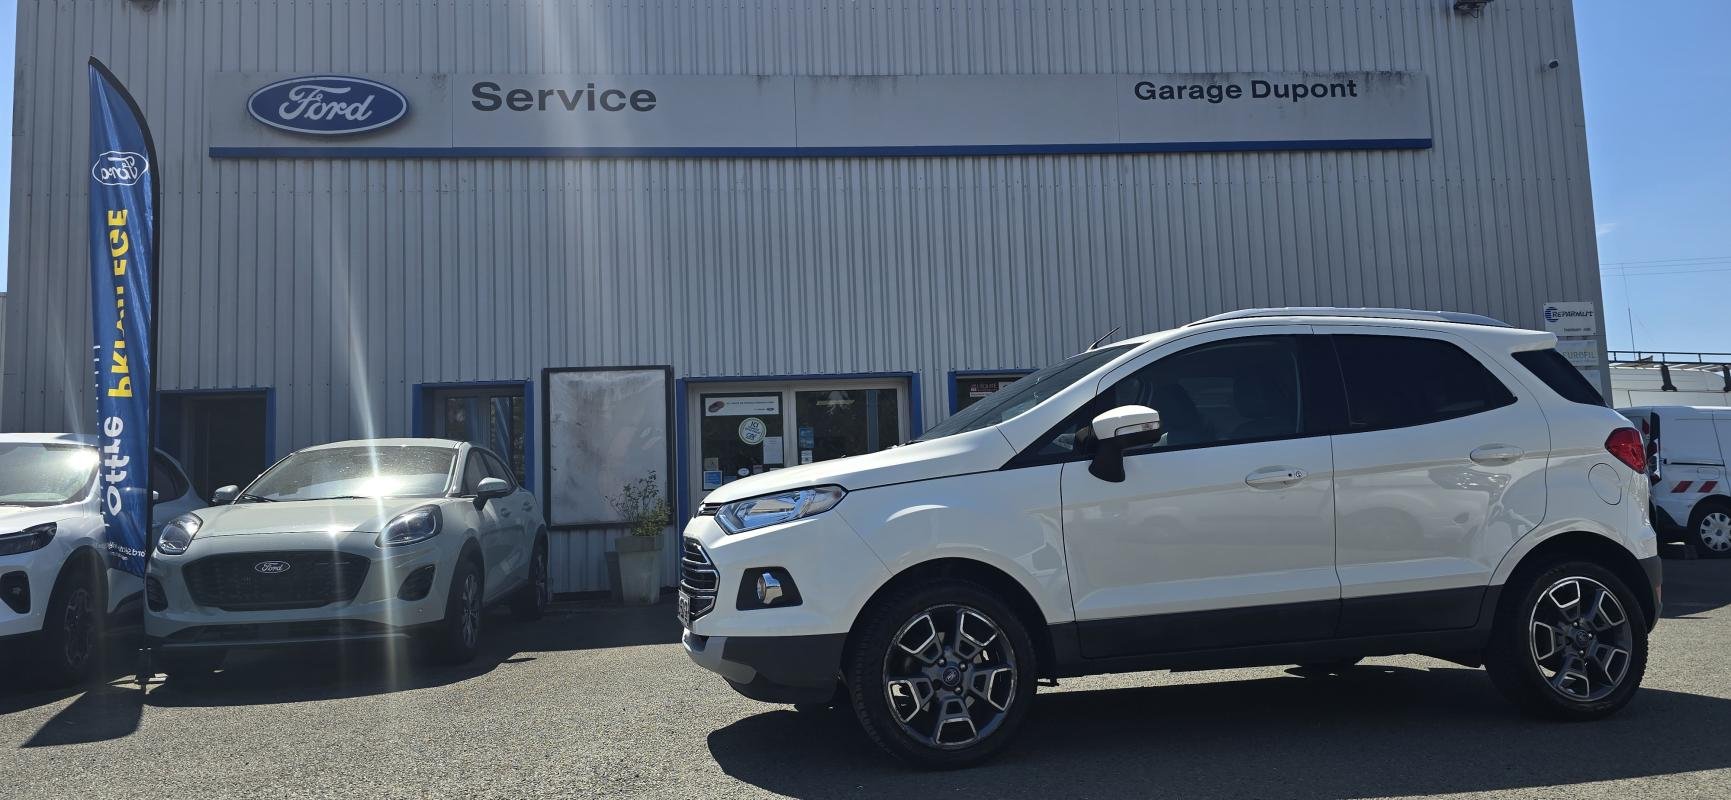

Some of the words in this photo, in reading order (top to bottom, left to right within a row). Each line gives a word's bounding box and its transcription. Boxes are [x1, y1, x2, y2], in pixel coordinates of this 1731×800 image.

[278, 84, 375, 121] Ford
[471, 81, 657, 112] Service
[1134, 80, 1243, 104] Garage
[1251, 78, 1358, 103] Dupont
